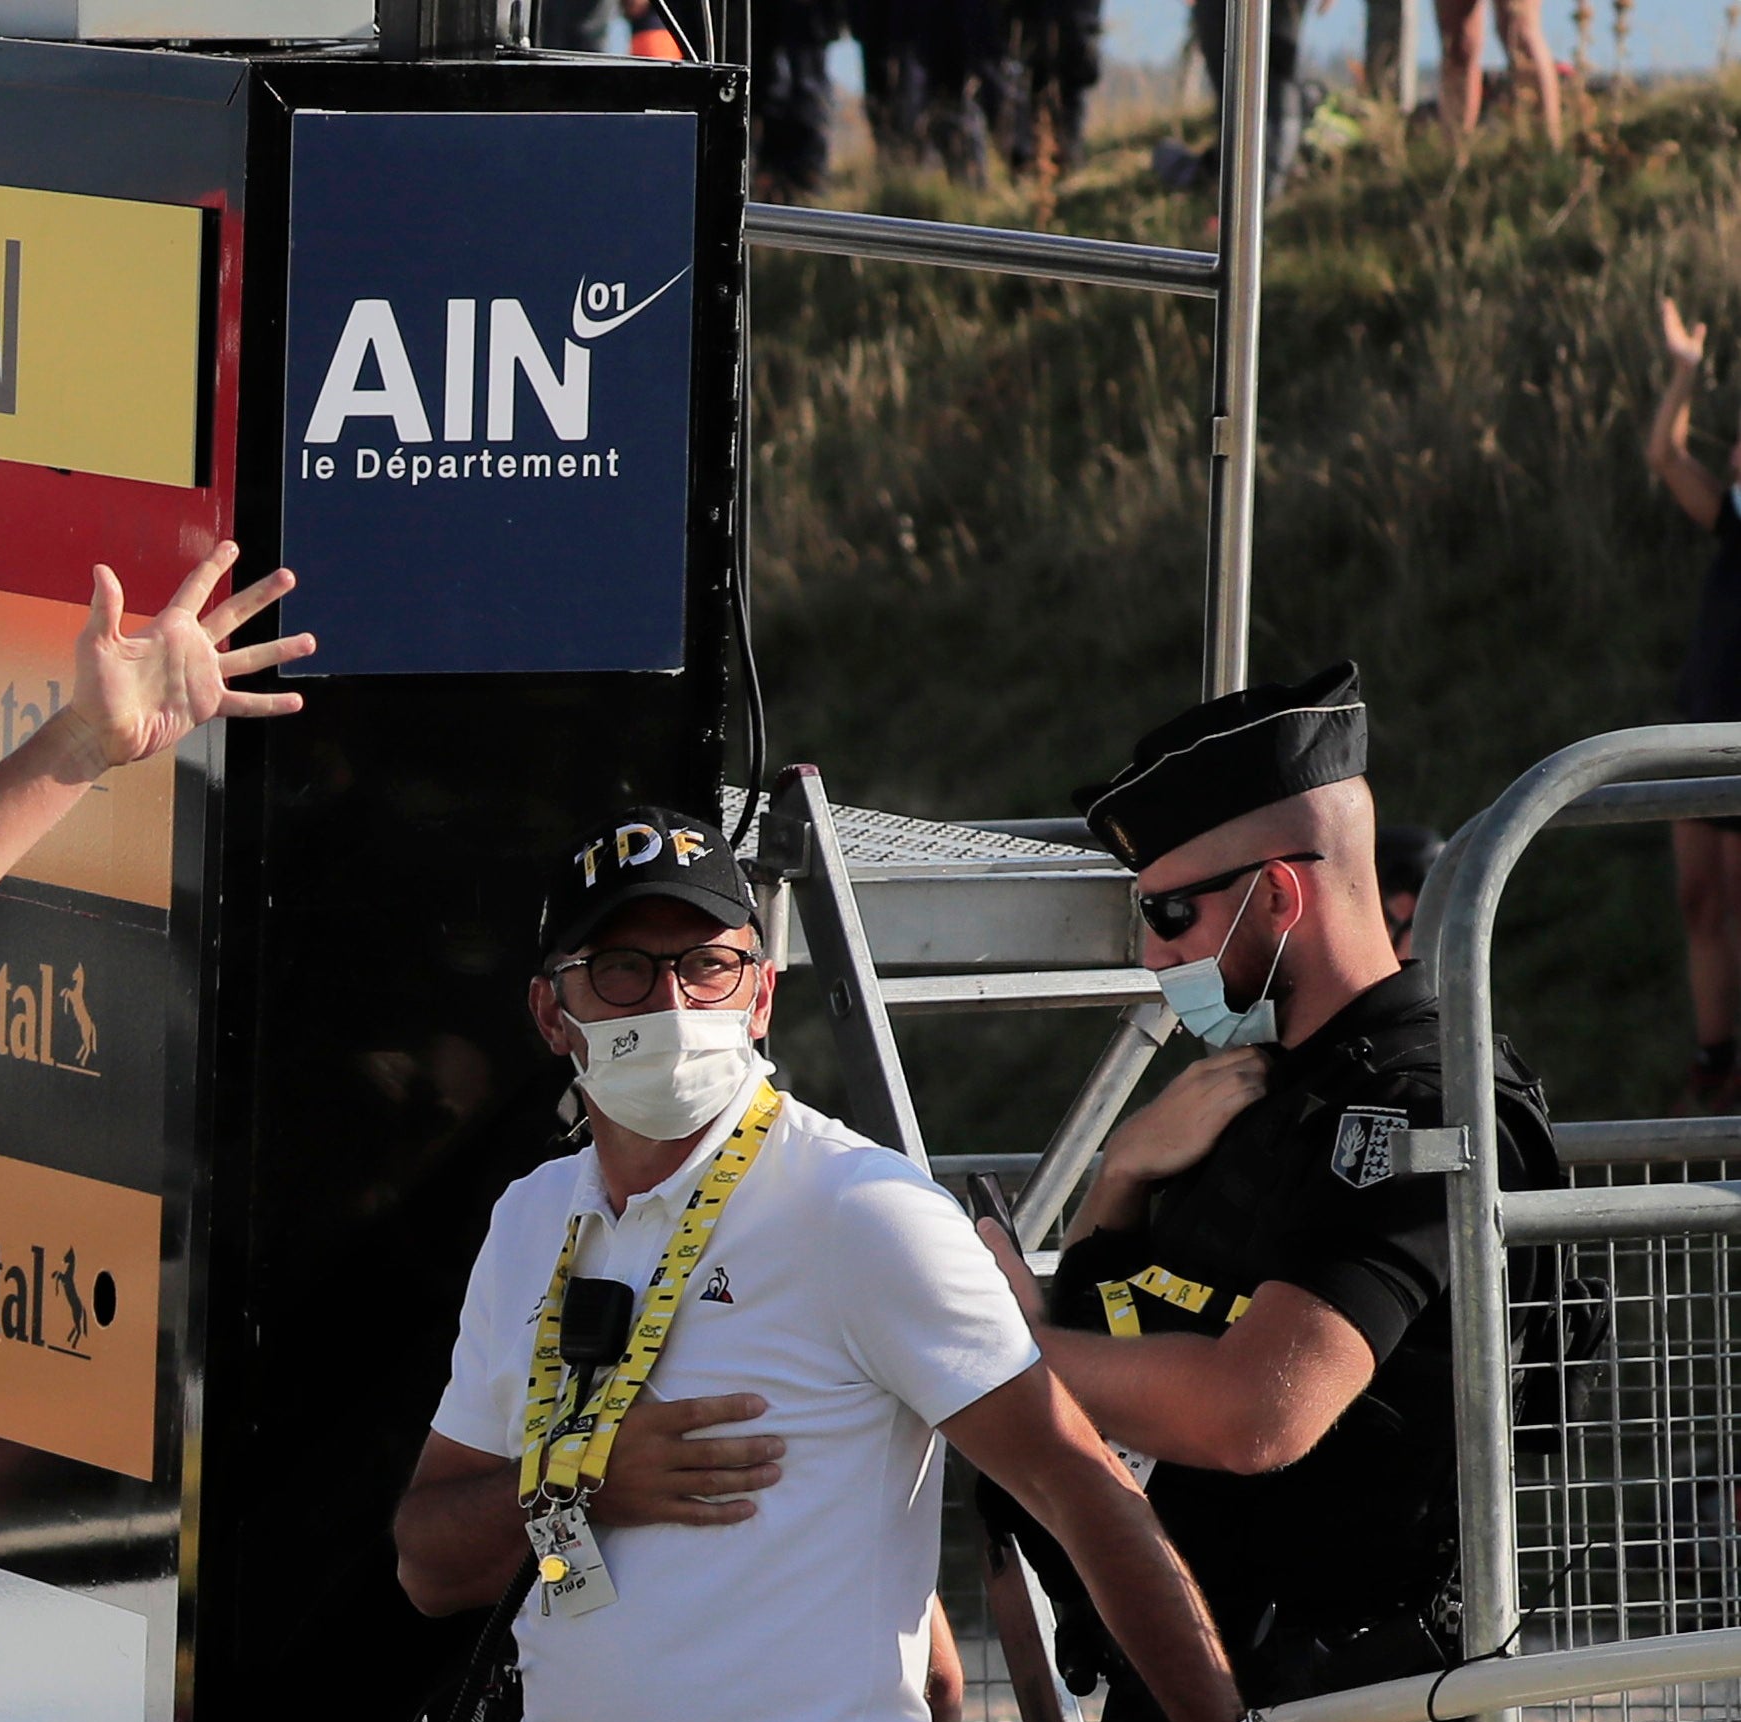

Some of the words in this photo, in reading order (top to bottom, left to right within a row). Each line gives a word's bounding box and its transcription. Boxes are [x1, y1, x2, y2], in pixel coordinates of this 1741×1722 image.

[587, 282, 627, 312] 01
[303, 297, 592, 443] AIN
[302, 449, 335, 480] le
[356, 447, 620, 485] Département
[574, 823, 706, 888] TDF
